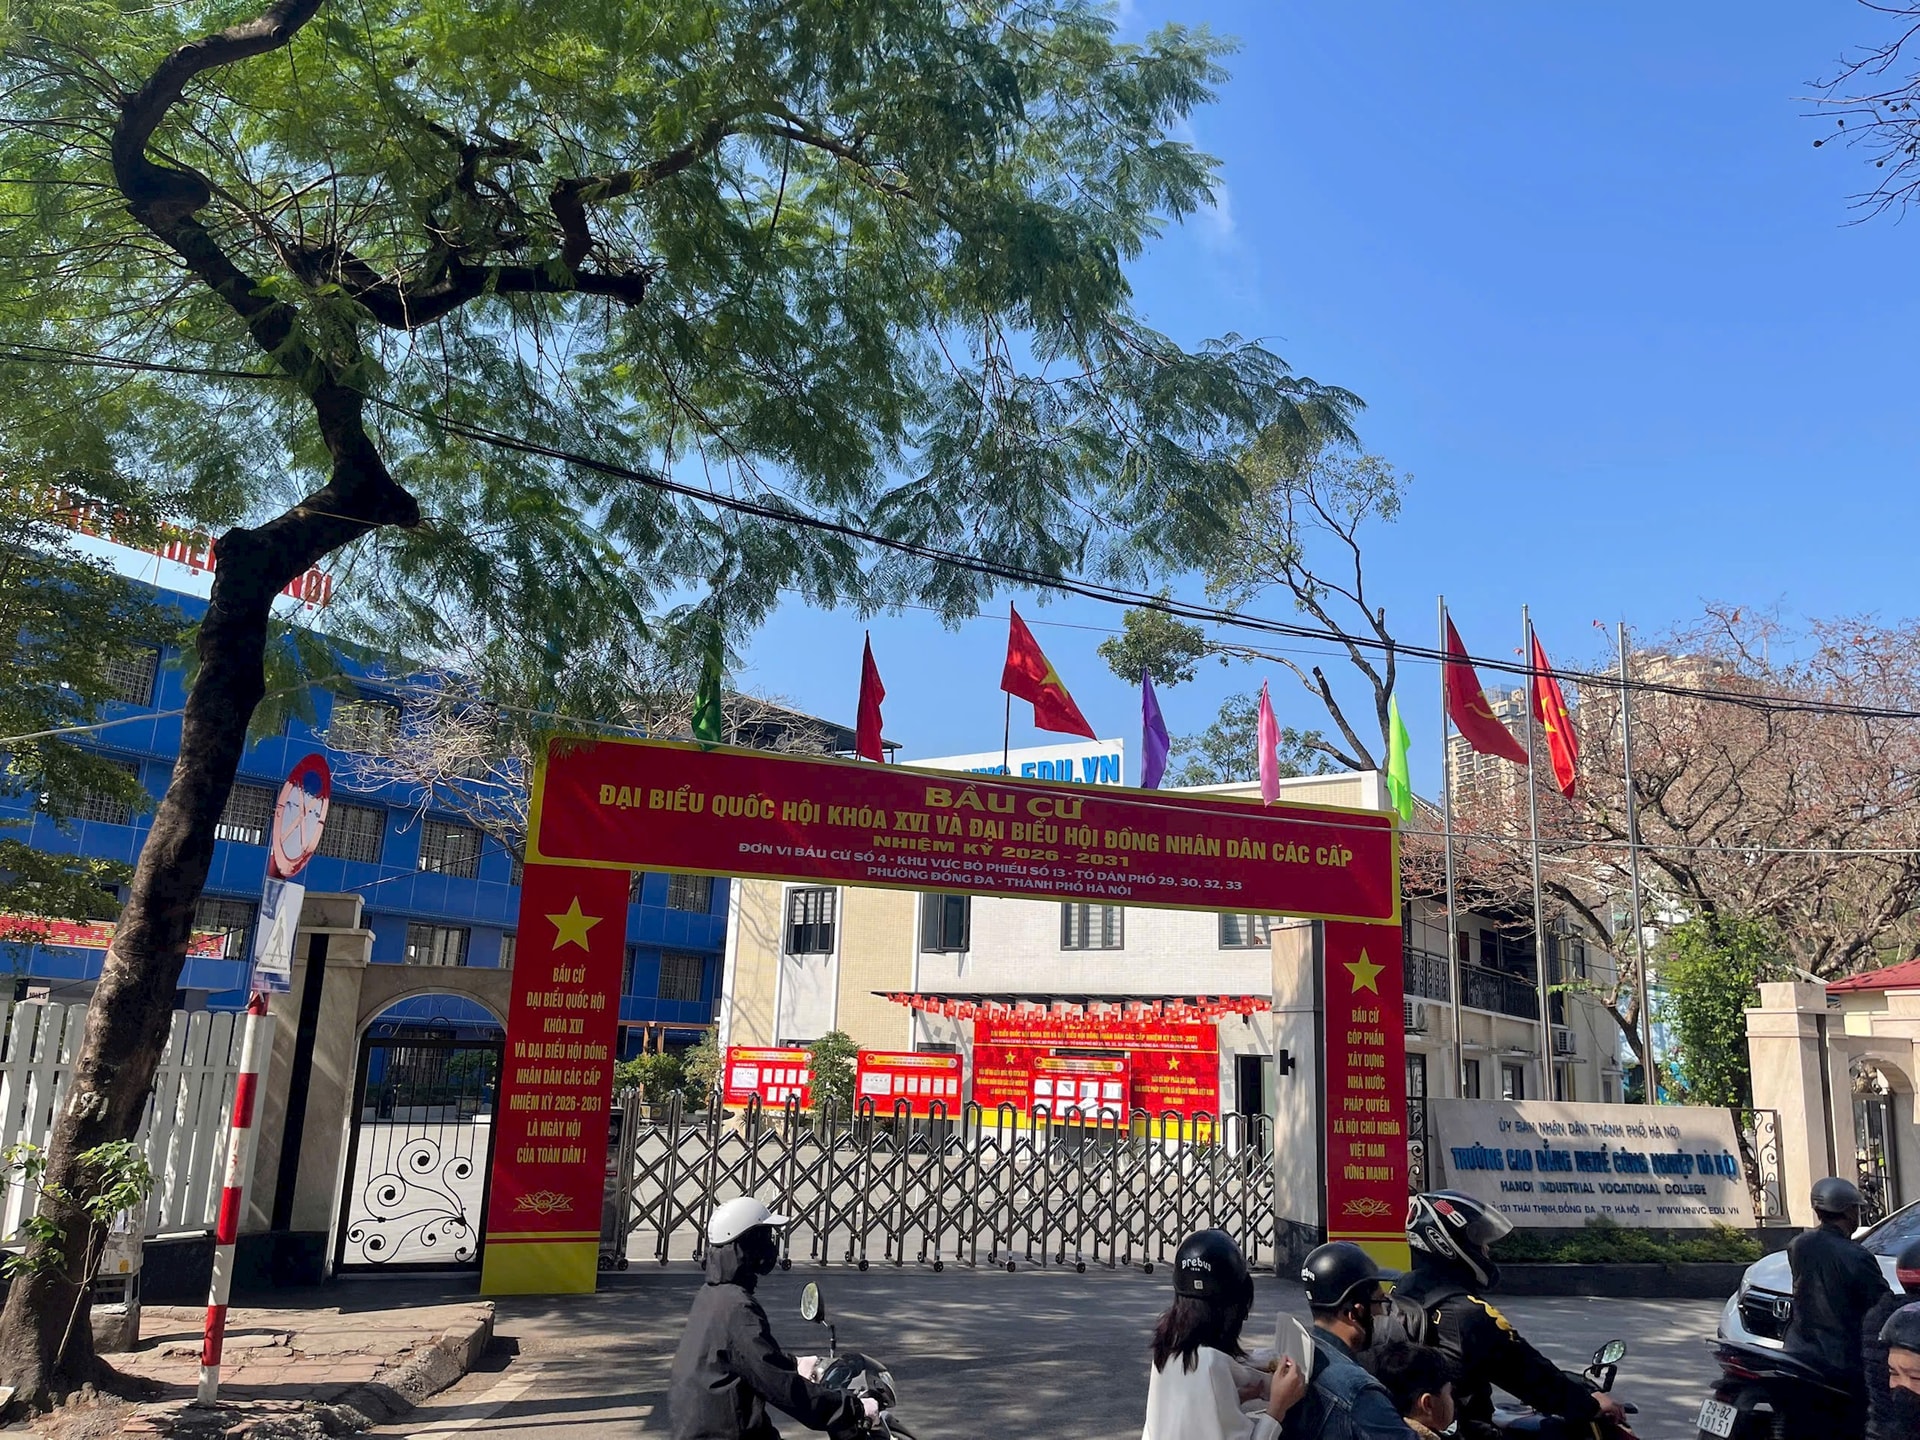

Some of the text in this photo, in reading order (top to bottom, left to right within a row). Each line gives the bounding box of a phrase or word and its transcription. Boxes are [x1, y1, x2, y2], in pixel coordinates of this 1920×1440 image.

[925, 784, 1015, 813] BẦU
[599, 784, 1353, 867] ĐẠI BIỂU QUỐC HỘI KHÓA XVI VÀ ĐẠI BIỂU HỘI ĐỒNG NHÂN DÂN CÁC CẤP
[873, 835, 955, 853] NHIỆM
[963, 842, 993, 856] KỲ
[1002, 847, 1059, 862] 2026
[1076, 853, 1129, 867] 2031
[738, 842, 773, 855] ĐƠN
[854, 851, 875, 862] SỐ
[877, 854, 887, 863] 4
[897, 855, 927, 866] KHU
[986, 861, 1027, 874] PHIẾU
[1030, 865, 1049, 877] SỐ
[1052, 868, 1065, 877] 13
[1097, 870, 1126, 882] DÂN
[1129, 872, 1156, 884] PHỐ
[1159, 876, 1177, 887] 29,
[1180, 878, 1202, 888] 30,
[1204, 880, 1223, 890] 32,
[1226, 881, 1243, 890] 33
[867, 866, 928, 880] PHƯỜNG
[931, 869, 972, 883] ĐỐNG
[974, 875, 995, 885] ĐA
[1005, 877, 1052, 889] THÀNH
[1055, 880, 1084, 892] PHỐ
[1086, 882, 1105, 893] HÀ
[1108, 884, 1132, 896] NỘI
[572, 964, 586, 983] CỬ
[526, 987, 605, 1013] ĐẠI BIỂU QUỐC HỘI
[543, 1015, 584, 1034] KHÓA XVI
[1368, 1006, 1379, 1023] CỬ
[1347, 1028, 1362, 1044] GÓP
[515, 1039, 526, 1057] VÀ
[528, 1043, 543, 1061] ĐẠI
[544, 1037, 565, 1059] BIỂU
[567, 1041, 582, 1062] HỘI
[1348, 1051, 1384, 1070] XÂY DỰNG
[516, 1065, 601, 1085] NHÂN DÂN CÁC CẤP
[1347, 1073, 1385, 1090] NHÀ NƯỚC
[510, 1091, 540, 1113] NHIỆM
[541, 1092, 553, 1110] KỲ
[554, 1096, 576, 1111] 2026
[581, 1096, 601, 1111] 2031
[1343, 1096, 1364, 1111] PHÁP
[527, 1118, 581, 1140] LÀ NGÀY HỘI
[1334, 1117, 1400, 1137] XÃ HỘI CHỦ NGHĨA
[1515, 1120, 1536, 1134] BAN
[1539, 1120, 1565, 1136] NHÂN
[1568, 1119, 1589, 1135] DÂN
[1590, 1120, 1622, 1137] THÀNH
[1626, 1118, 1646, 1138] PHỐ
[1648, 1123, 1662, 1137] HÀ
[517, 1142, 534, 1163] CỦA
[537, 1144, 560, 1163] TOÀN
[561, 1144, 581, 1163] DÂN
[1350, 1141, 1385, 1159] VIỆT NAM
[1451, 1141, 1505, 1171] TRƯỜNG
[1506, 1148, 1533, 1171] CAO
[1612, 1146, 1649, 1174] CÔNG
[1649, 1148, 1694, 1179] NGHIỆP
[1695, 1149, 1714, 1175] HÀ
[1343, 1163, 1364, 1180] VỮNG
[1366, 1166, 1389, 1183] MẠNH
[1500, 1181, 1707, 1195] HANOI INDUSTRIAL VOCATIONAL COLLEGE
[1615, 1204, 1627, 1214] HÀ
[1628, 1203, 1640, 1216] NỘI
